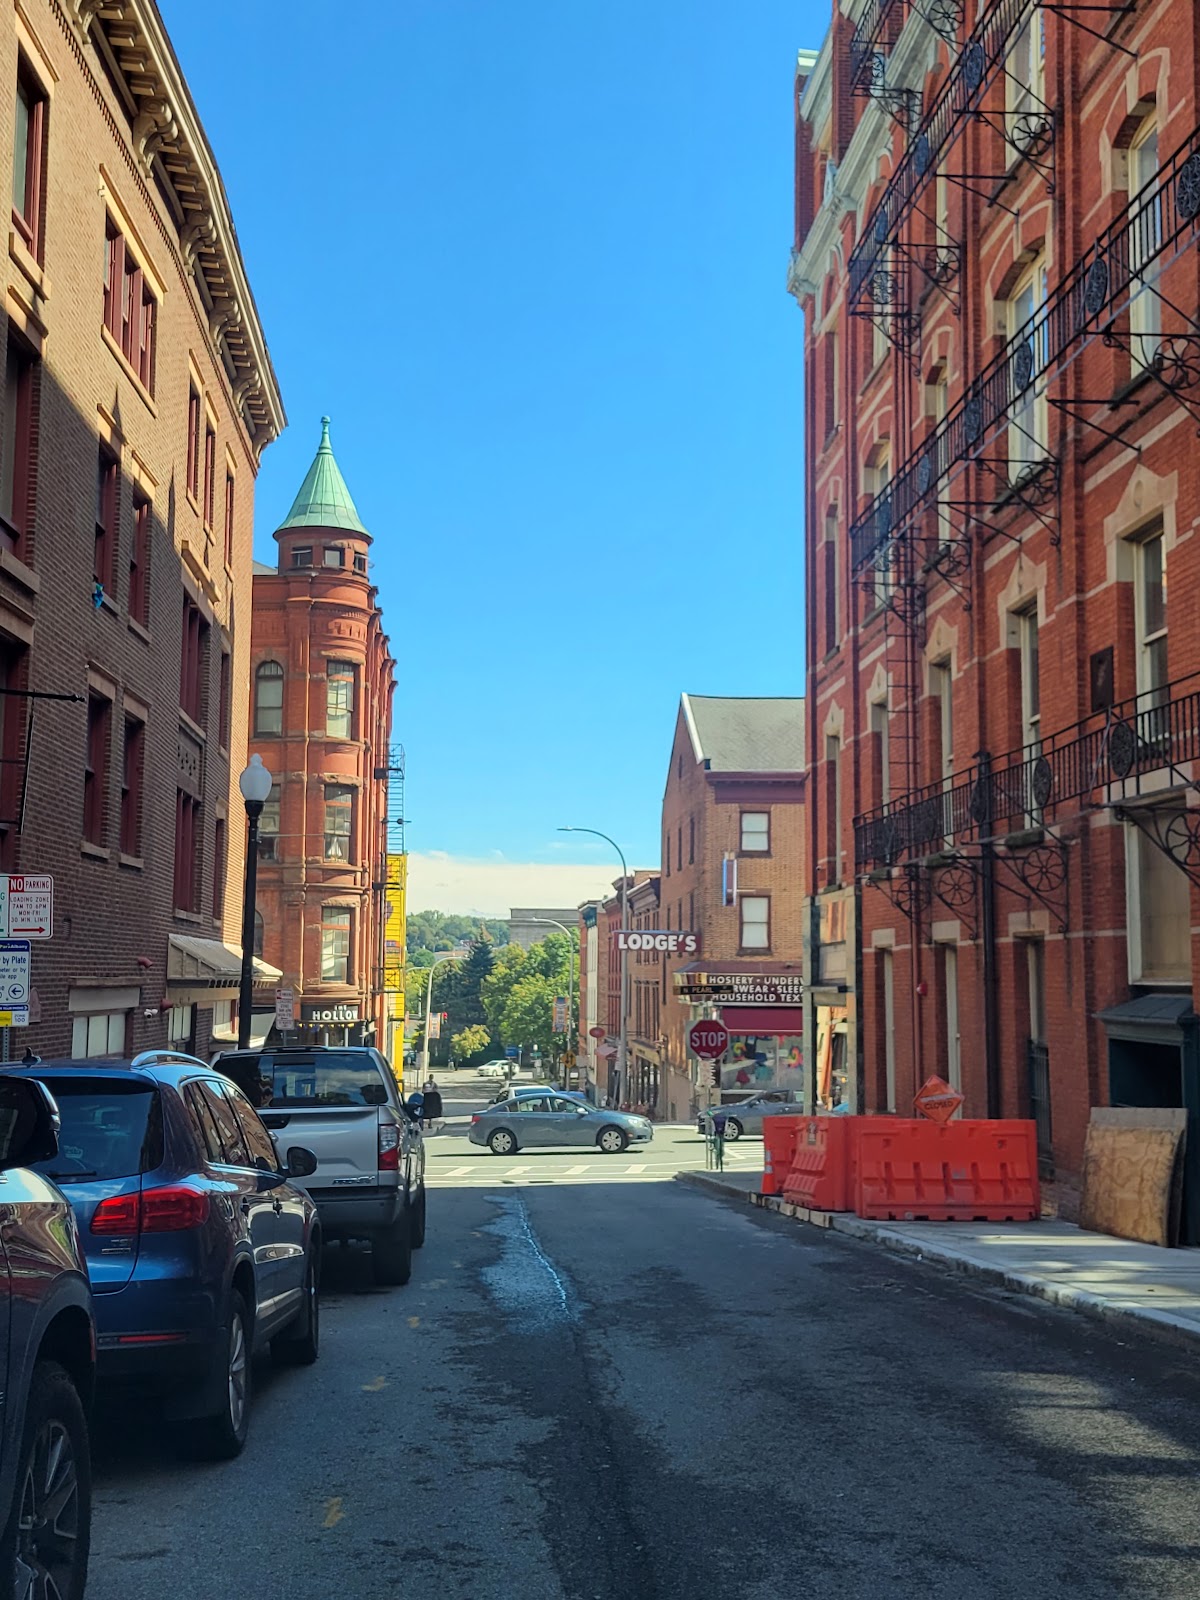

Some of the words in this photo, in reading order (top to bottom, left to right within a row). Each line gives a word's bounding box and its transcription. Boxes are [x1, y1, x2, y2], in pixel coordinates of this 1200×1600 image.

[10, 879, 24, 891] NO
[26, 881, 49, 889] PARKING
[618, 933, 697, 951] LODGE'S
[2, 955, 9, 966] by
[11, 955, 26, 964] Plate
[709, 976, 753, 985] HOSIERY
[711, 994, 776, 1002] HOUSEHOLD
[691, 1031, 726, 1047] STOP
